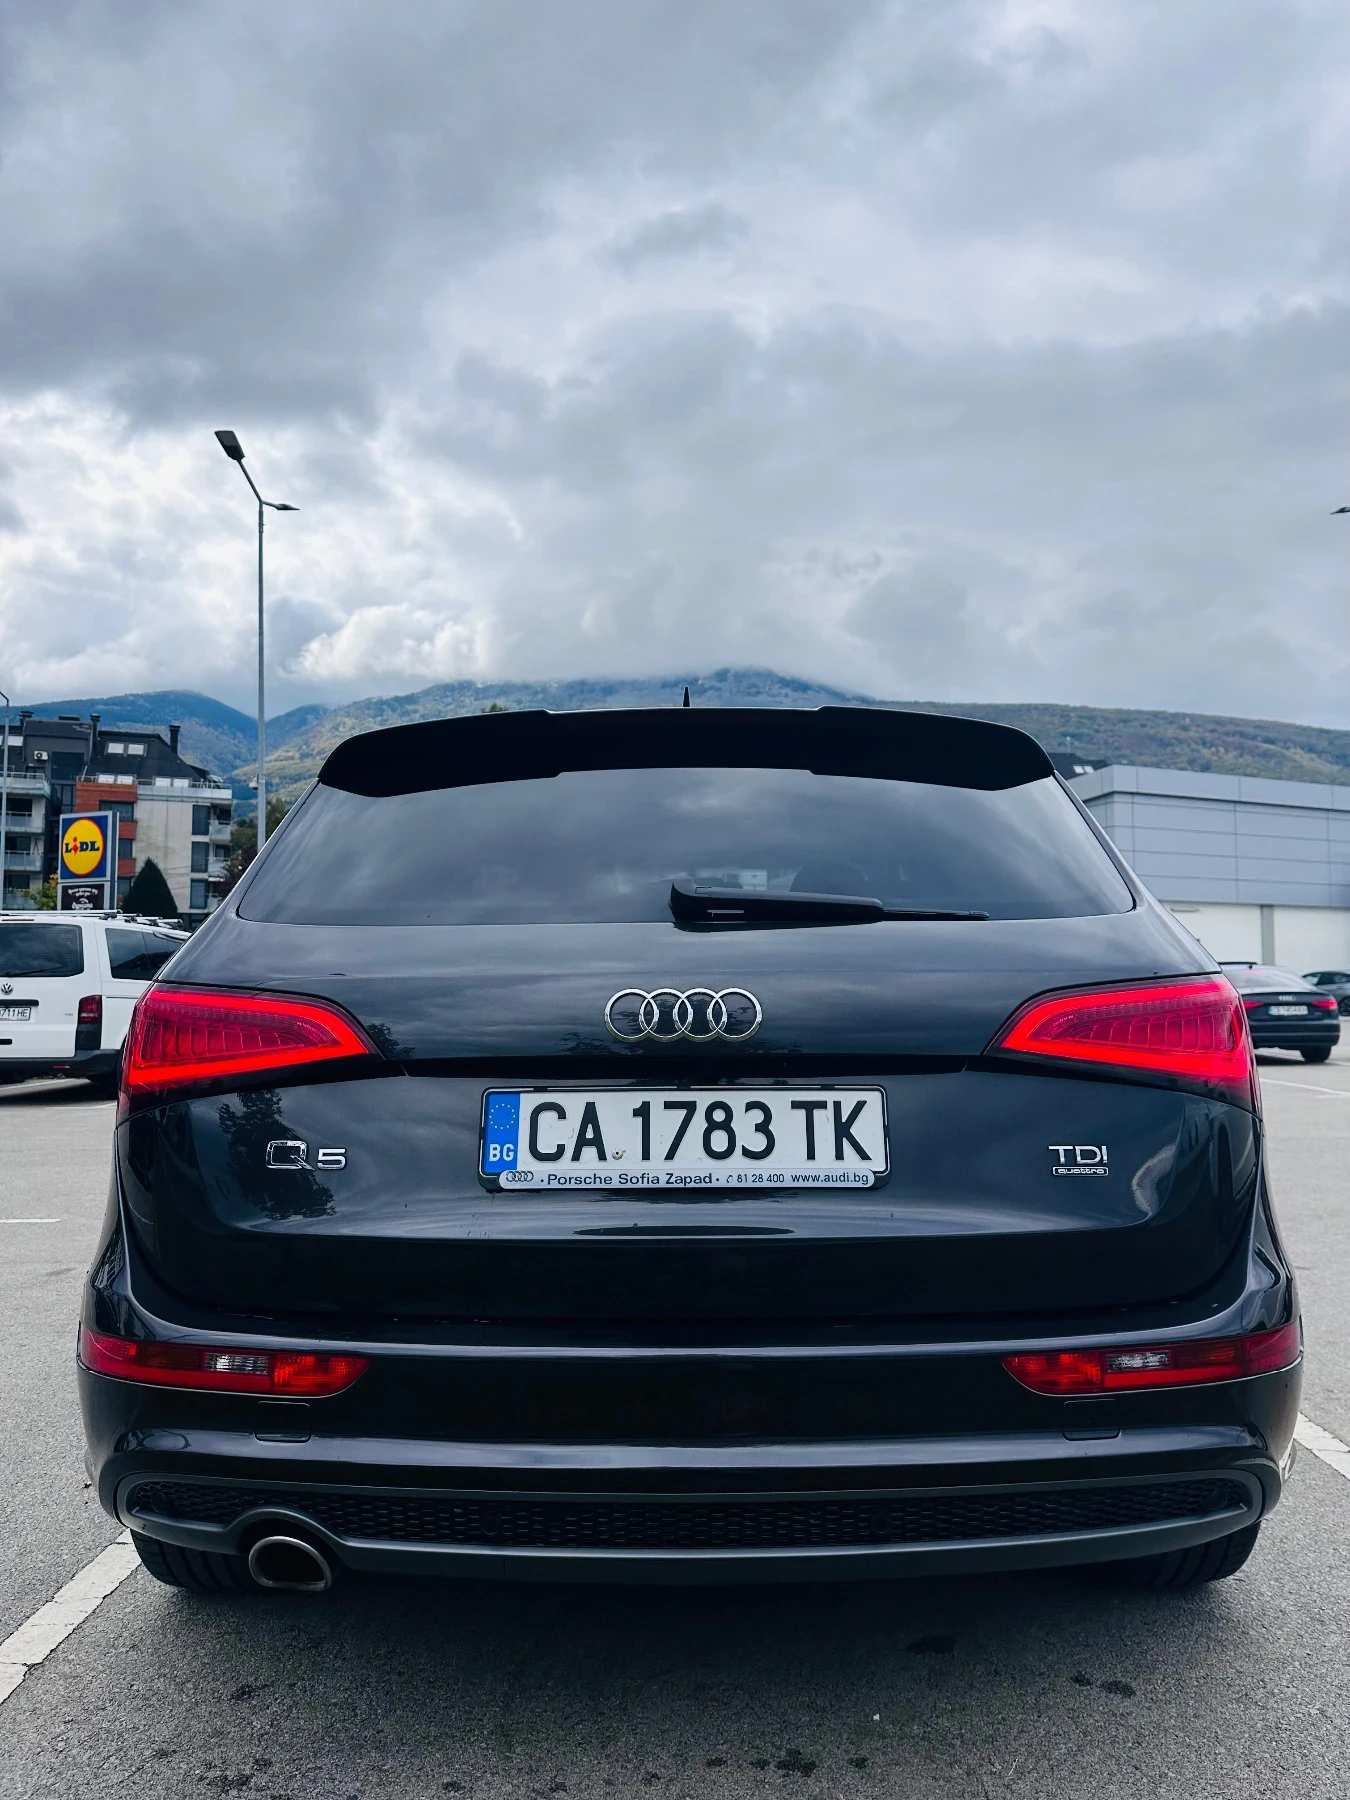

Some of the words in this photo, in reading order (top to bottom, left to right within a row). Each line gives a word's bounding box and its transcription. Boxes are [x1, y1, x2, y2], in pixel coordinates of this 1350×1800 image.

[0, 1008, 16, 1017] 711
[528, 1101, 607, 1162] CA
[632, 1100, 776, 1162] 1783
[790, 1100, 872, 1161] TK
[265, 1140, 346, 1170] Q5
[488, 1143, 515, 1162] BG
[1048, 1145, 1108, 1164] TDI
[547, 1173, 613, 1185] Porsche
[618, 1172, 660, 1185] Sofia
[665, 1173, 712, 1187] Zapad
[790, 1172, 869, 1185] www.audi.bg
